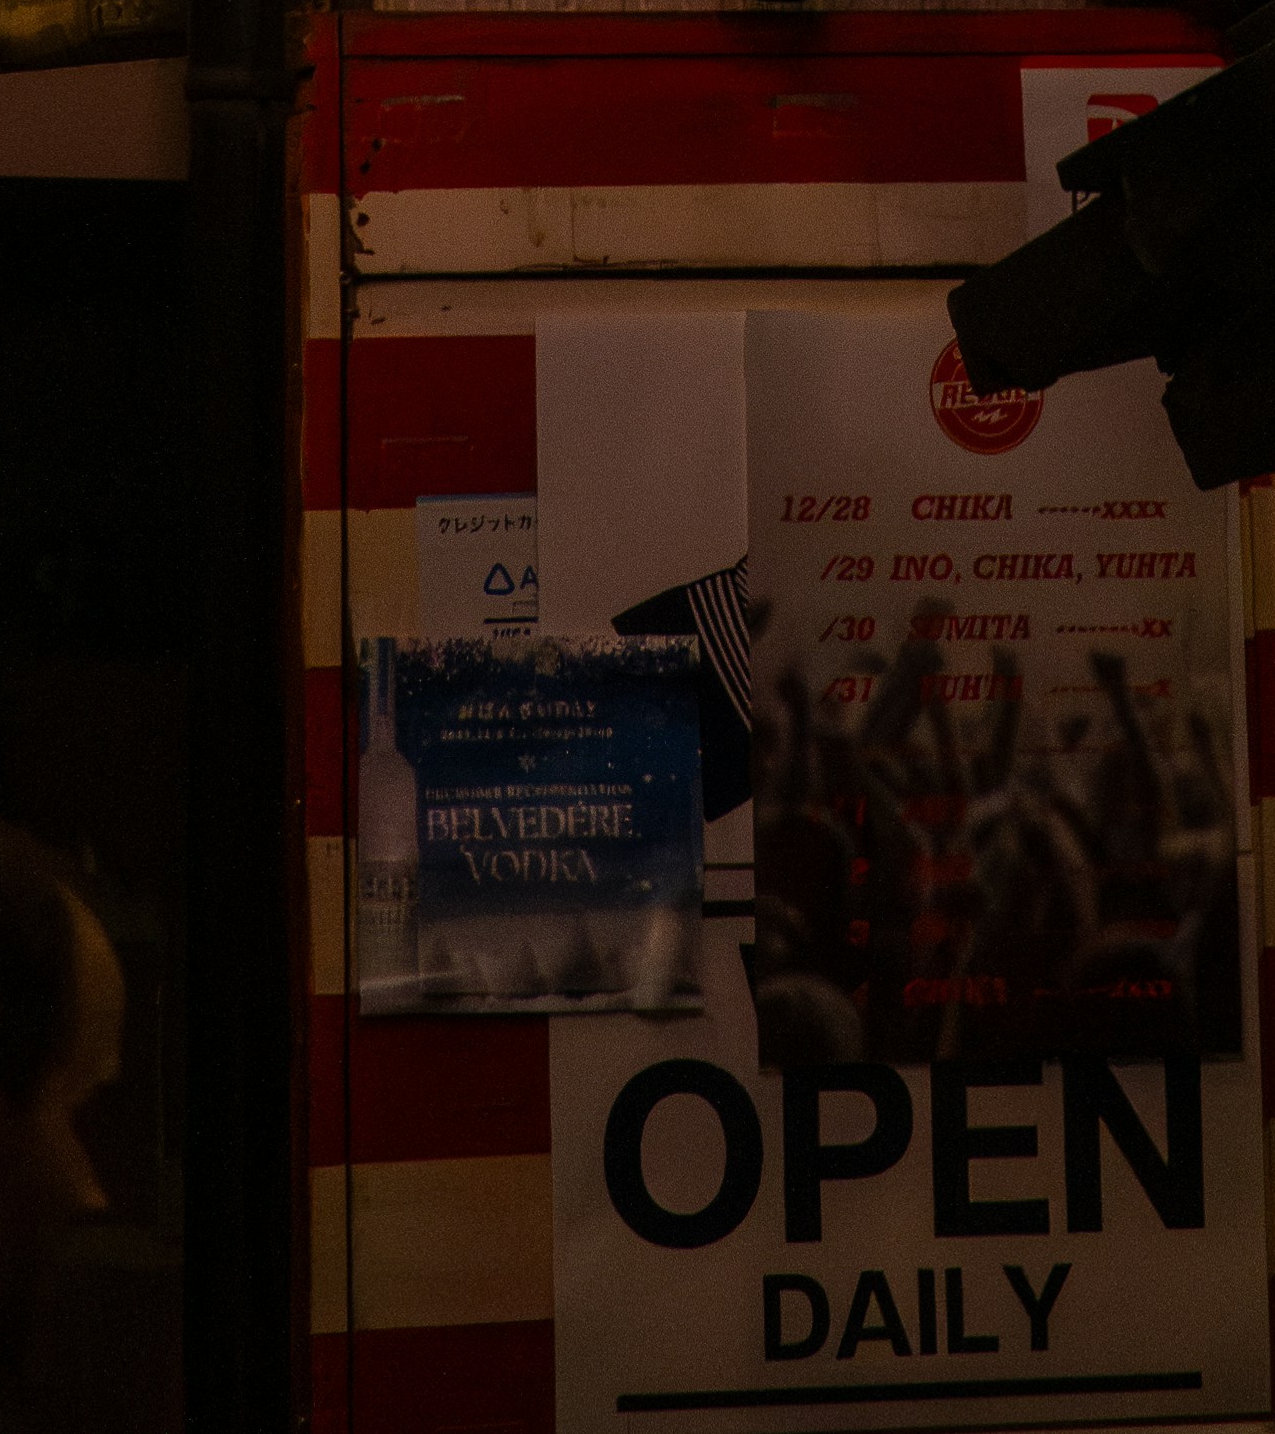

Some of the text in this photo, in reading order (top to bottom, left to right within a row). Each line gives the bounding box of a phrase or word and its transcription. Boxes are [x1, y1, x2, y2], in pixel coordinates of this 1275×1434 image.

[780, 495, 871, 522] 12/28
[911, 493, 1014, 521] CHIKA
[821, 551, 1197, 584] /29 INO, CHIKA, YUHTA
[820, 615, 875, 642] /30
[908, 614, 1031, 642] SUMITA
[821, 676, 874, 703] /31
[459, 846, 599, 885] VODKA
[603, 1055, 1205, 1251] OPEN
[761, 1261, 1073, 1362] DAILY
